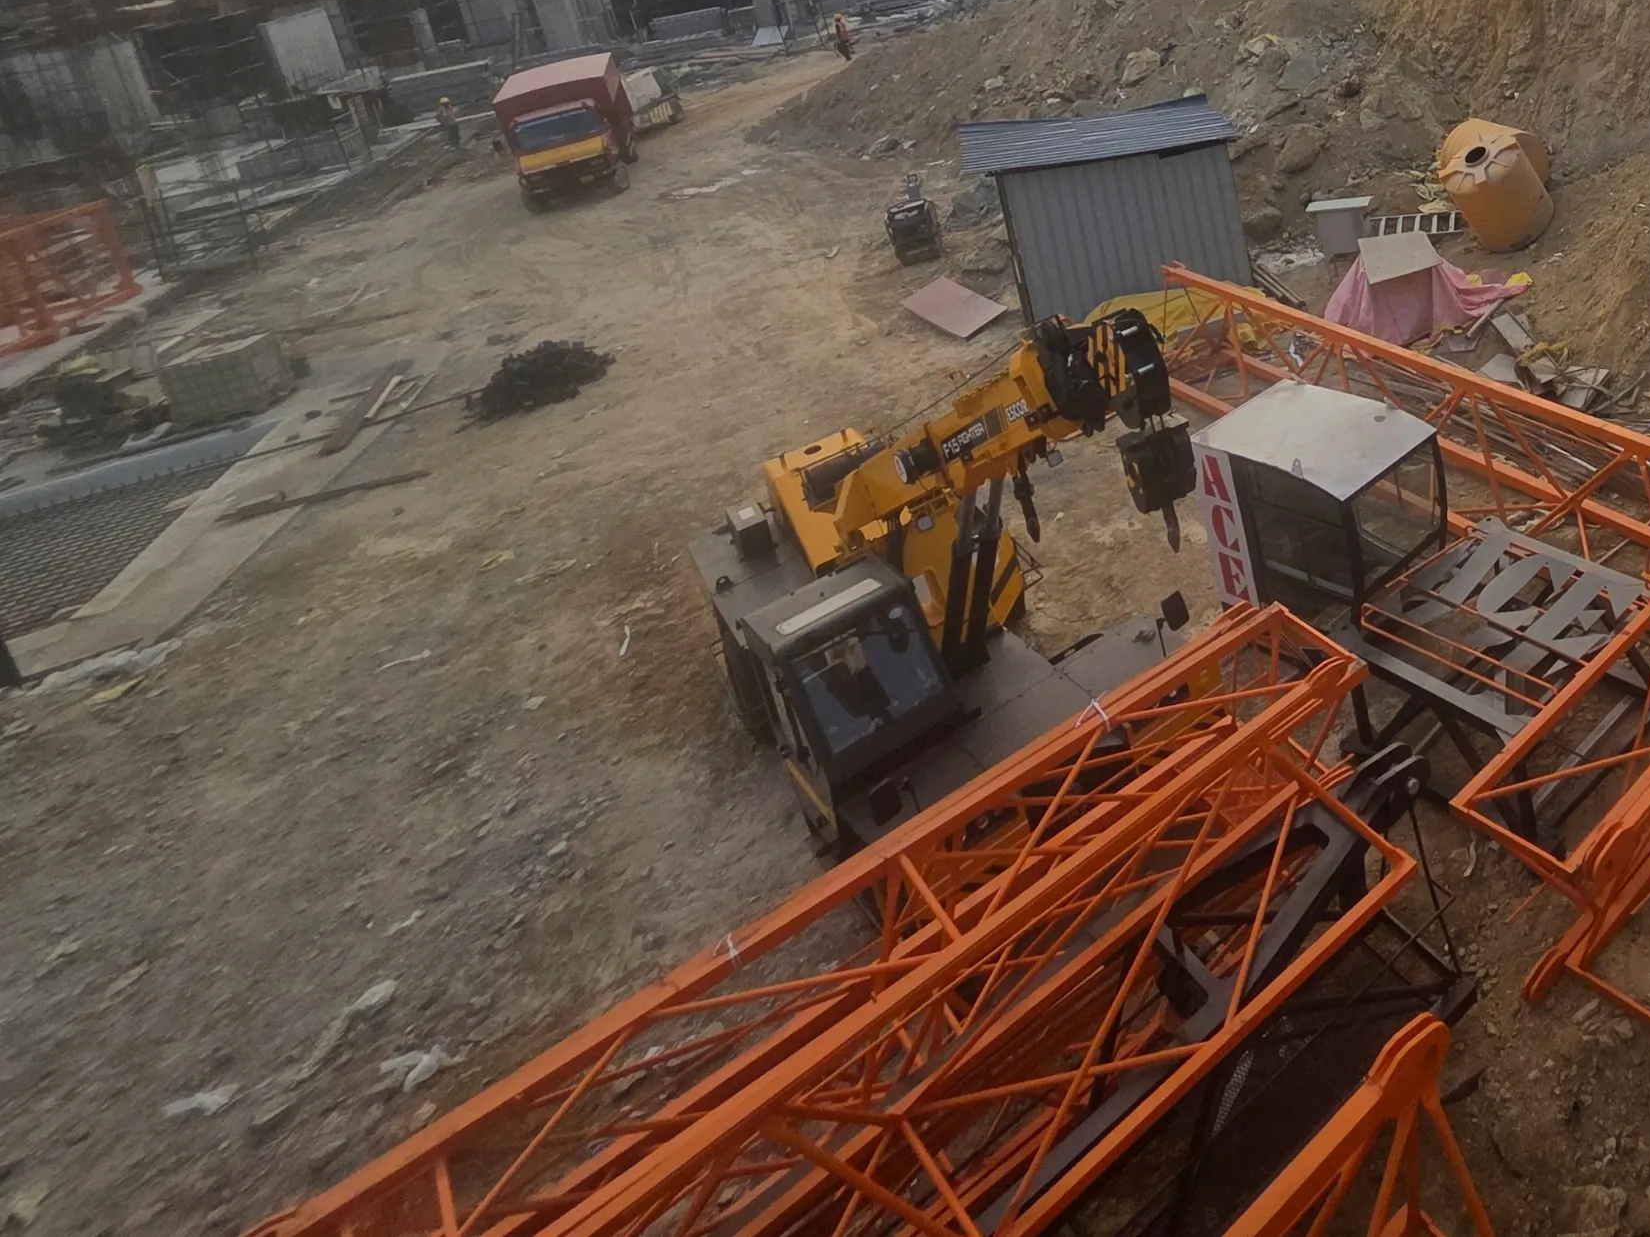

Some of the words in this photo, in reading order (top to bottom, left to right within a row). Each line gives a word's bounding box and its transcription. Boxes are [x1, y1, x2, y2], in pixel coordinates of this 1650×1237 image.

[942, 437, 961, 458] F15
[957, 422, 985, 446] FIGHTER
[1202, 454, 1250, 600] ACE
